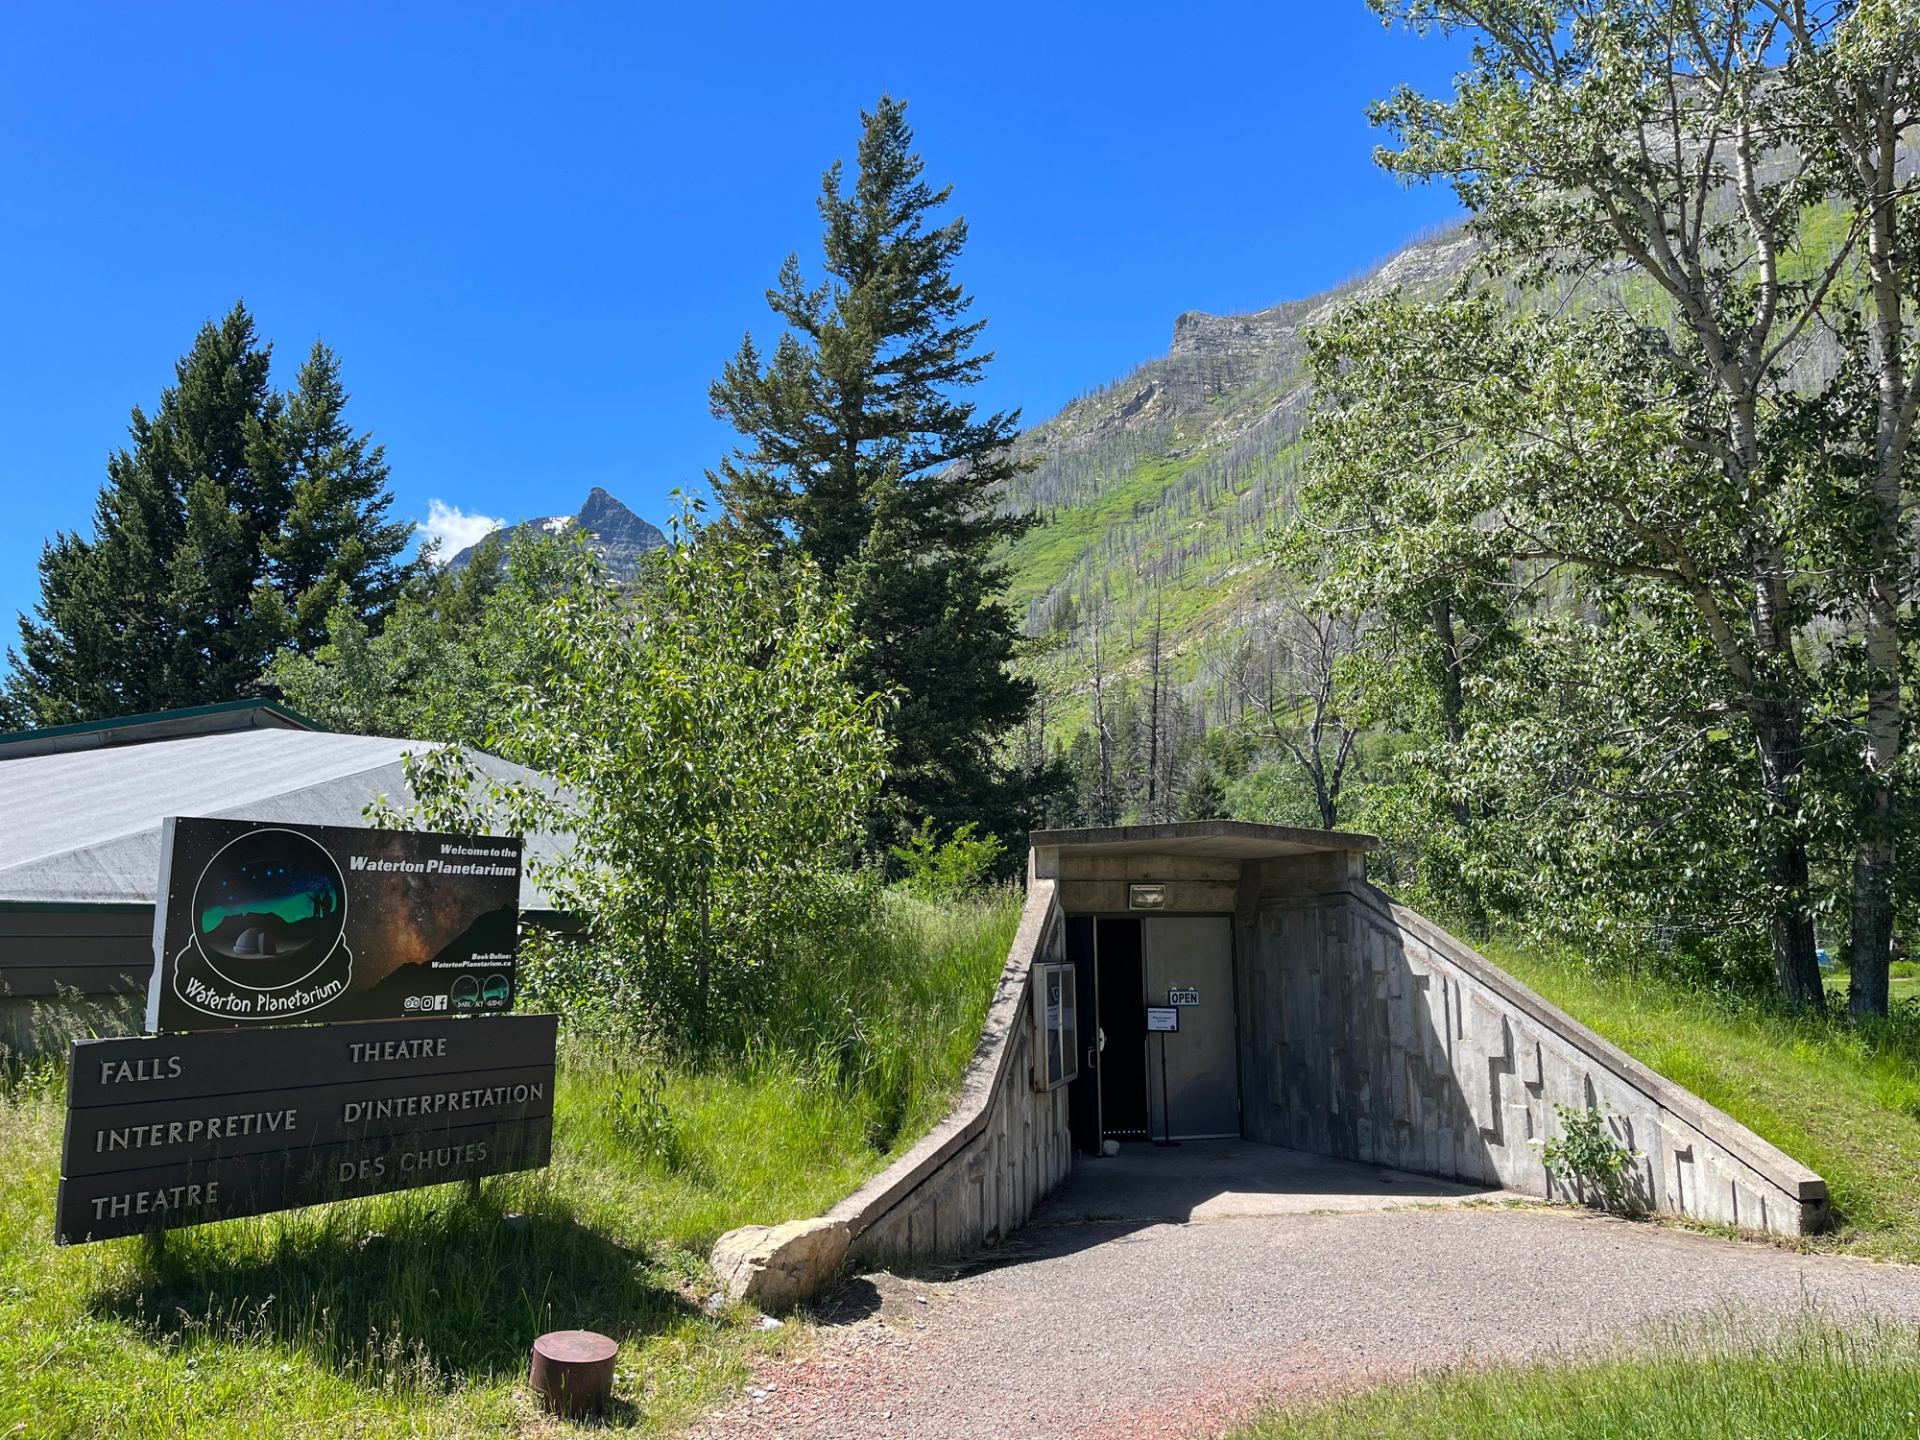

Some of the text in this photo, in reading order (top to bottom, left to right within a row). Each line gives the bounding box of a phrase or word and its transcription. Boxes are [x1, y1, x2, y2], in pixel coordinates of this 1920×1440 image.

[440, 844, 518, 858] Welcome to the
[350, 856, 517, 877] Waterton Planetarium
[431, 960, 512, 969] WatertonPlanetarium.ca
[471, 952, 489, 960] Book
[185, 976, 342, 1012] Waterton Planetarium
[1171, 993, 1198, 1004] OPEN
[349, 1038, 448, 1064] THEATRE
[100, 1056, 182, 1085] FALLS
[344, 1083, 544, 1123] D'INTERPRETATION
[95, 1109, 297, 1153] INTERPRETIVE
[339, 1142, 488, 1183] DES CHUTES
[92, 1181, 219, 1220] THEATRE
